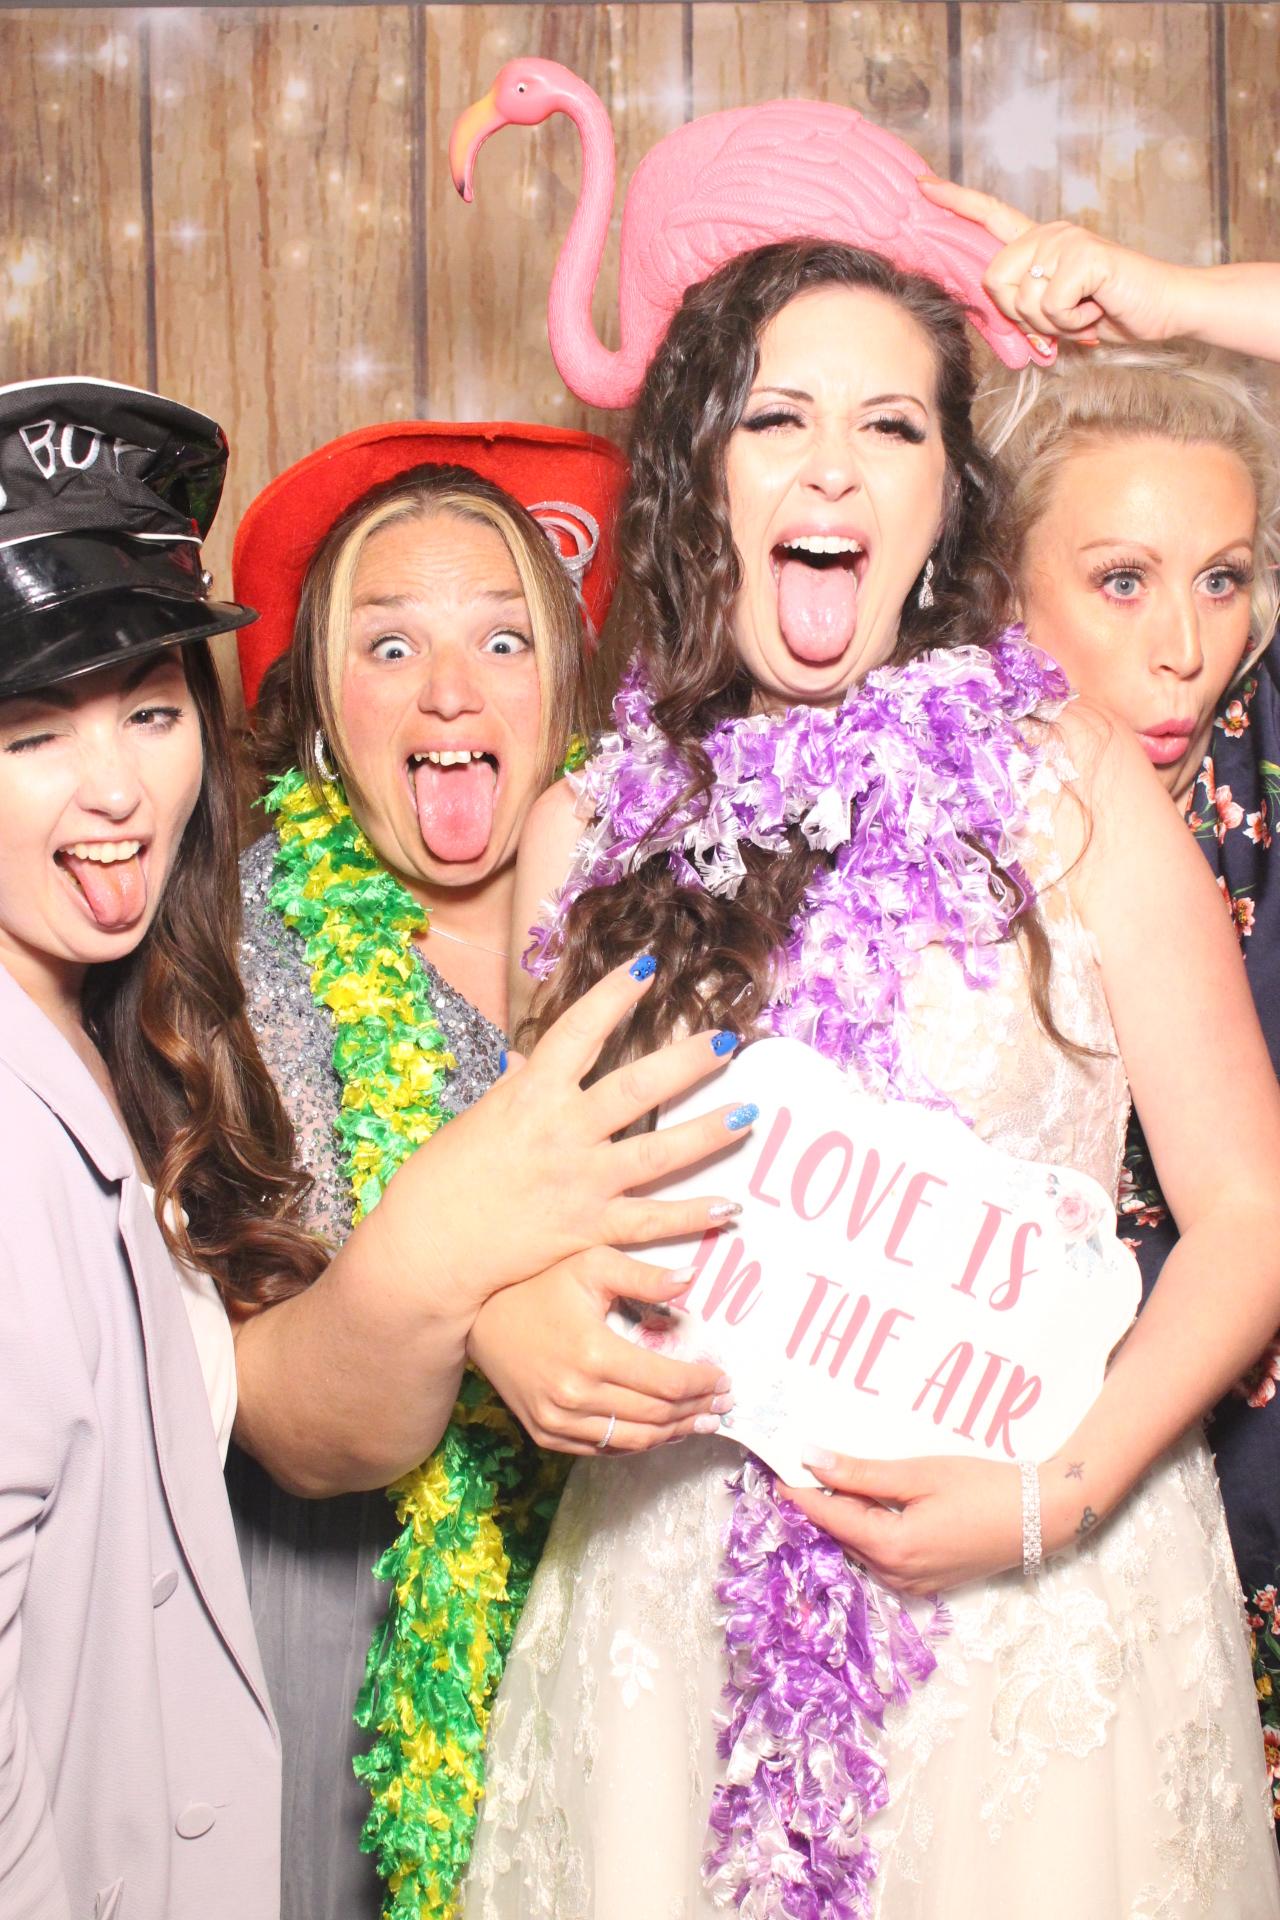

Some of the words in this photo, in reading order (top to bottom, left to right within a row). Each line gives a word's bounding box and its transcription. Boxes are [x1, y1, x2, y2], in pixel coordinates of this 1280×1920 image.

[748, 1106, 948, 1267] LOVE
[950, 1200, 1043, 1312] IS
[784, 1271, 916, 1397] THE
[911, 1340, 1043, 1458] AIR
